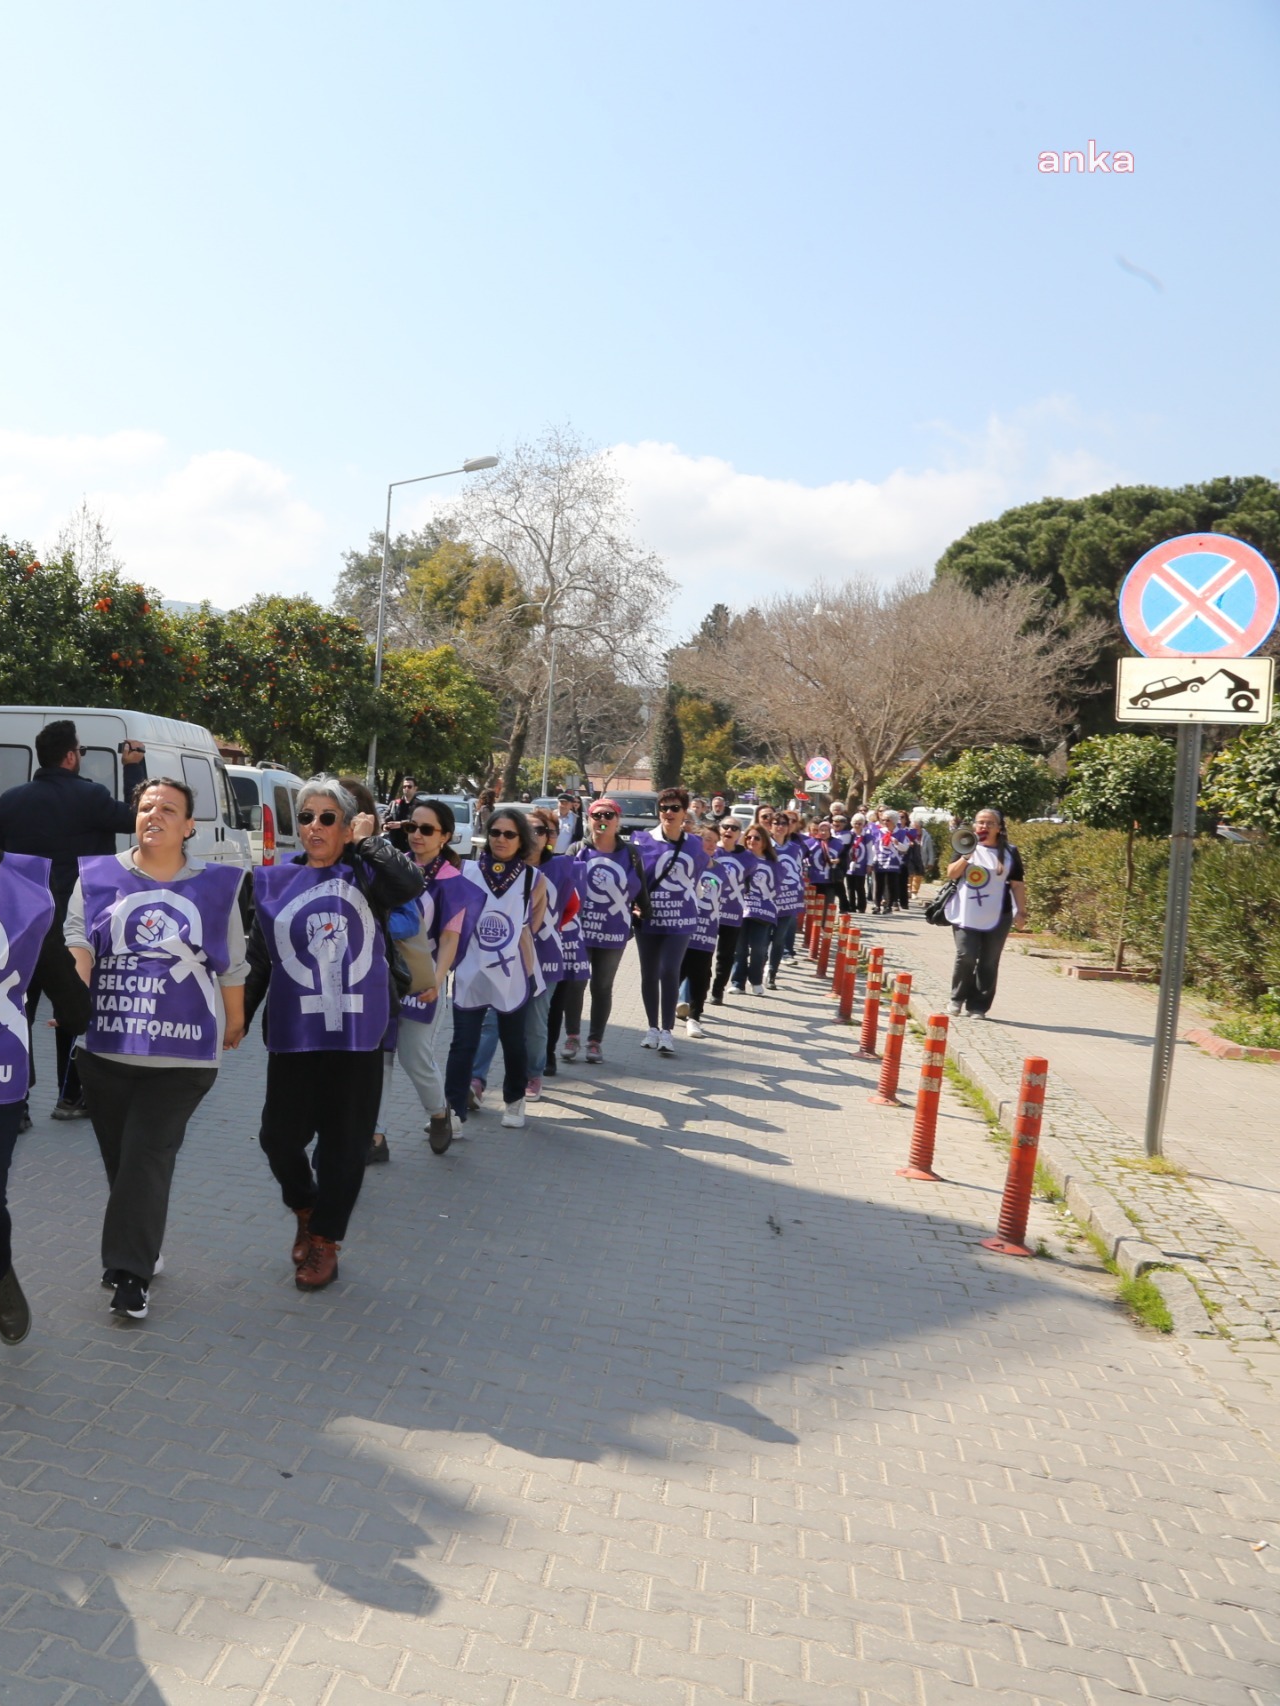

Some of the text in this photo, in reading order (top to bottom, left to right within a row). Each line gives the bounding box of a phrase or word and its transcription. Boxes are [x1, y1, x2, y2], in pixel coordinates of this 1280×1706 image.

[100, 955, 139, 970] EFES
[98, 975, 167, 995] SELÇUK
[96, 995, 156, 1014] KADIN
[97, 1016, 202, 1041] PLATFORMU
